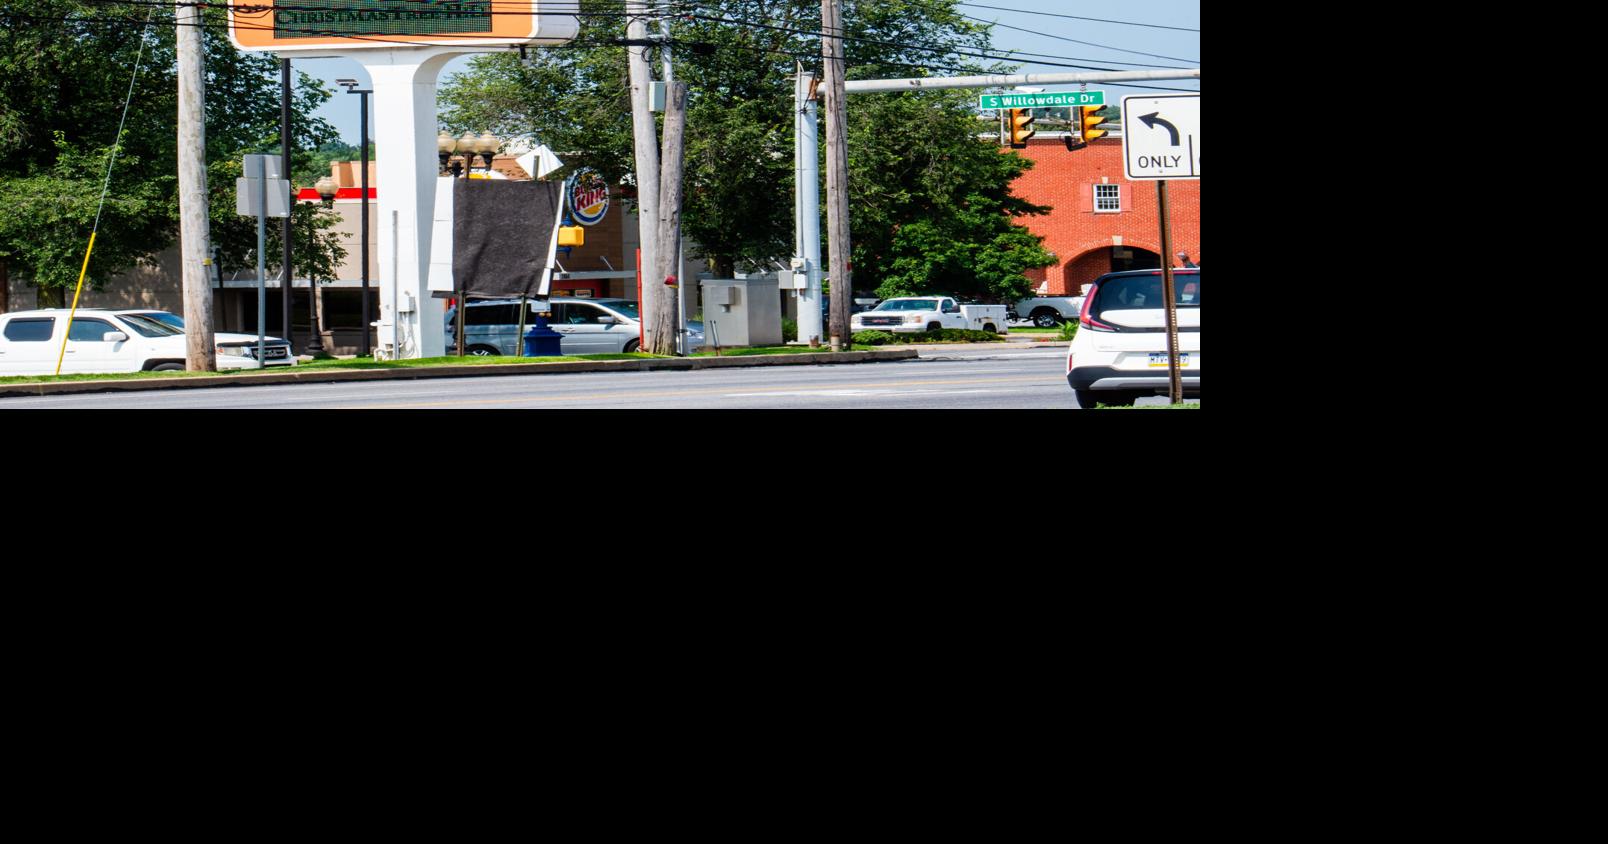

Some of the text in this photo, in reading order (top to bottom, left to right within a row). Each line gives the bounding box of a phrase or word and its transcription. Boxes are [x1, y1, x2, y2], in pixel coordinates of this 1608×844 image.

[990, 94, 1095, 106] S Willowdale Dr
[1138, 155, 1181, 168] ONLY
